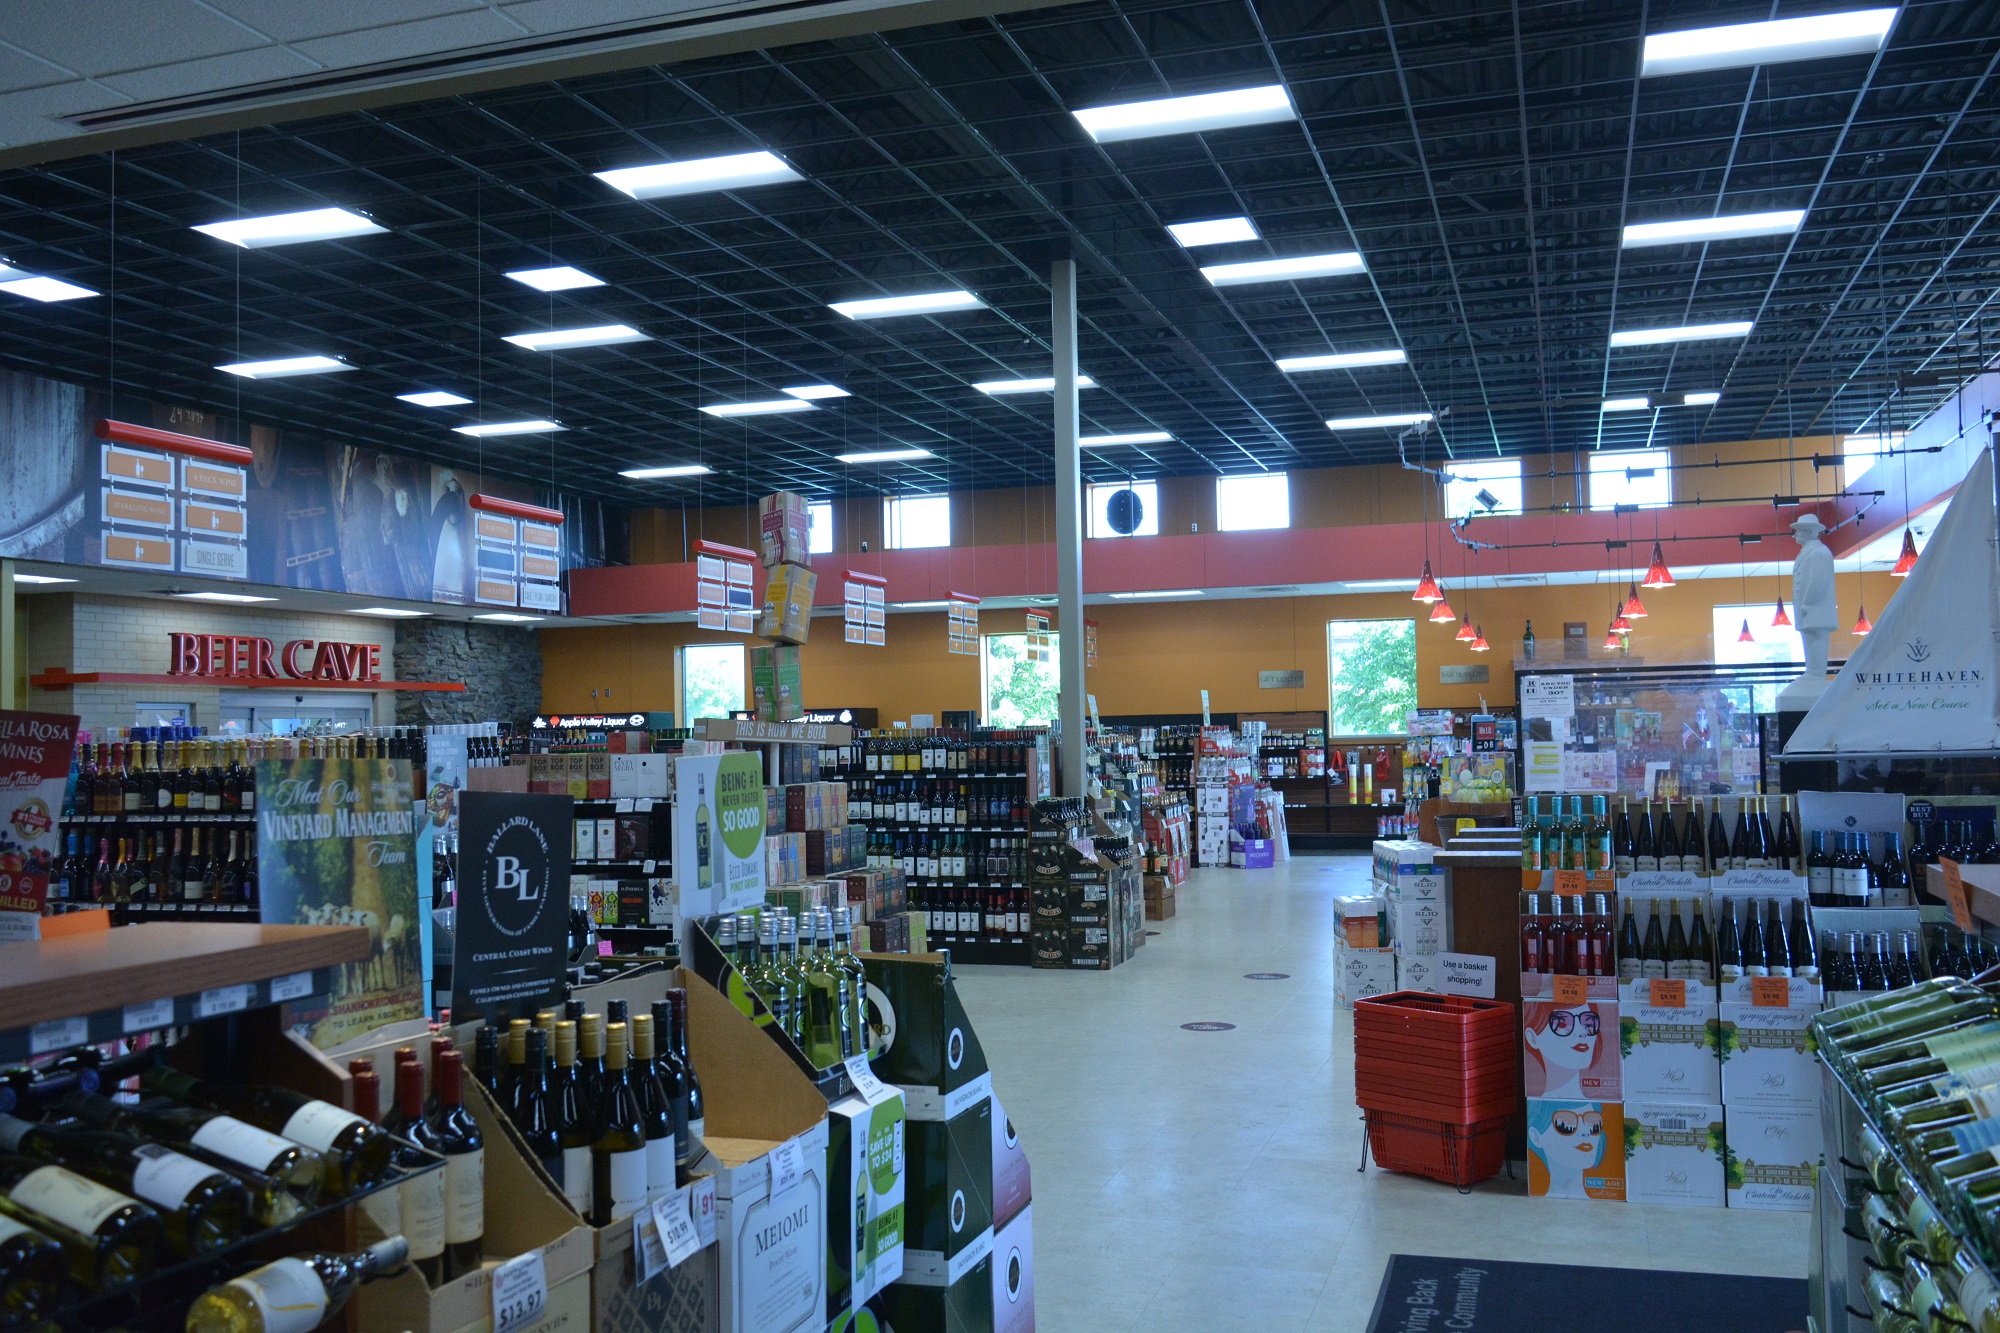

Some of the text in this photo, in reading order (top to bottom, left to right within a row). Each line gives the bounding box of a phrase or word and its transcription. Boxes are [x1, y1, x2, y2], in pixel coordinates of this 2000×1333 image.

[200, 474, 218, 484] PACK
[219, 477, 238, 488] WINE
[114, 502, 166, 516] SPARKLING WINE
[196, 550, 235, 568] SINGLE SERVE
[167, 632, 382, 682] BEER CAVE
[1865, 698, 1970, 712] Set a New Course
[559, 716, 628, 728] Apple Valley Liquor
[810, 714, 836, 723] Liquor
[28, 720, 70, 742] ROSA
[736, 721, 827, 740] THIS IS HOW WE BOTA
[14, 770, 42, 786] Taste
[721, 770, 758, 792] BEING #1
[275, 779, 323, 808] Meet
[328, 779, 362, 806] Our
[722, 791, 758, 807] NEVER TASTED
[18, 812, 28, 822] #1
[262, 808, 414, 842] VINEYARD MANAGEMENT
[723, 806, 760, 833] SO GOOD
[486, 816, 550, 854] BALLARD LANE
[366, 840, 407, 868] Team
[495, 856, 540, 900] BL
[730, 876, 759, 894] PINOT GRIGIO
[1632, 878, 1694, 888] Chateau Michelle
[1728, 876, 1792, 886] Chateau Michelle
[472, 946, 554, 962] CENTRAL COAST WINES
[1442, 960, 1456, 968] Use
[1463, 961, 1488, 972] basket
[469, 979, 548, 996] FAMILY OWNED AND COMMITTED
[1446, 975, 1482, 986] shopping!
[508, 990, 533, 1000] CENTRAL
[533, 986, 550, 996] COAST
[1640, 1009, 1704, 1019] Chateau Michelle
[1738, 1013, 1805, 1024] Chateau Michelle
[953, 1084, 983, 1107] SAUVIGNON BLANC
[869, 1135, 893, 1156] SAVE UP
[872, 1150, 893, 1170] TO $24
[702, 1192, 714, 1216] 91
[1746, 1190, 1812, 1201] Chateau Michelle
[755, 1204, 809, 1257] MEIOMI
[878, 1214, 898, 1231] BEING #1
[667, 1221, 689, 1244] $10.99
[877, 1230, 899, 1254] SO GOOD
[768, 1246, 798, 1272] Pinot Noir
[957, 1242, 986, 1270] SAUVIGNON BLANC
[1406, 1278, 1440, 1304] Back
[1444, 1267, 1488, 1328] Community
[500, 1290, 541, 1328] $13.97
